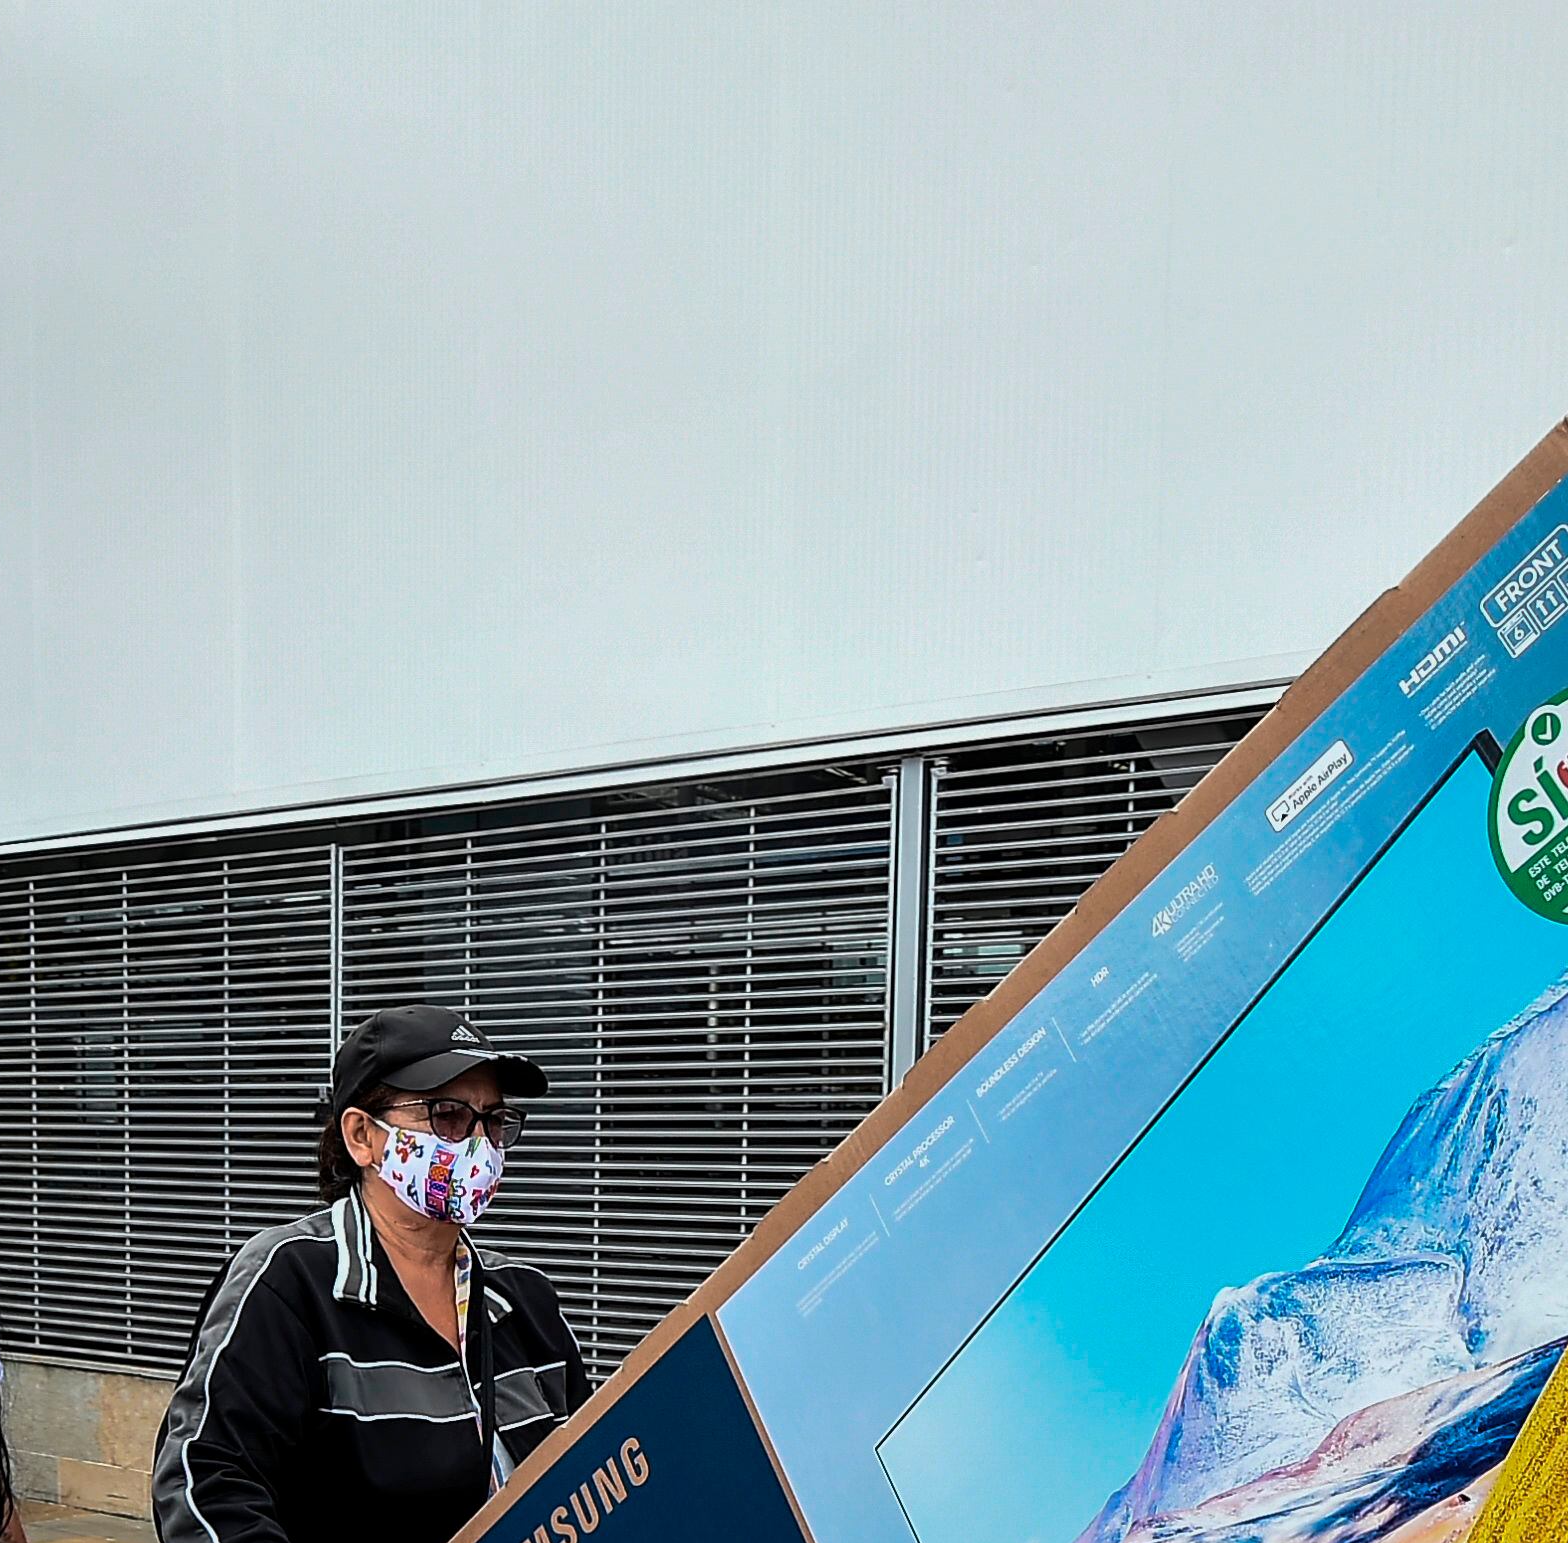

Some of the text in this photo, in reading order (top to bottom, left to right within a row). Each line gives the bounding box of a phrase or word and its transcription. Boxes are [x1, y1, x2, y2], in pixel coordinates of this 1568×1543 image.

[1495, 540, 1562, 612] FRONT
[1399, 626, 1467, 694] HDMI
[1511, 625, 1525, 641] 6
[1291, 752, 1350, 810] Apple AirPlay
[1529, 855, 1552, 878] ESTE
[1536, 875, 1551, 891] DE
[1151, 911, 1172, 938] 4K
[1164, 879, 1200, 917] ULTRA
[1195, 864, 1216, 888] HD
[1090, 966, 1110, 987] HDR
[975, 1048, 1020, 1098] BOUNDLESS
[1016, 1026, 1047, 1060] DESIGN
[884, 1153, 914, 1187] CRYSTAL
[912, 1115, 955, 1161] PROCESSOR
[918, 1156, 931, 1169] 4K
[797, 1217, 850, 1271] CRYSTAL DISPLAY
